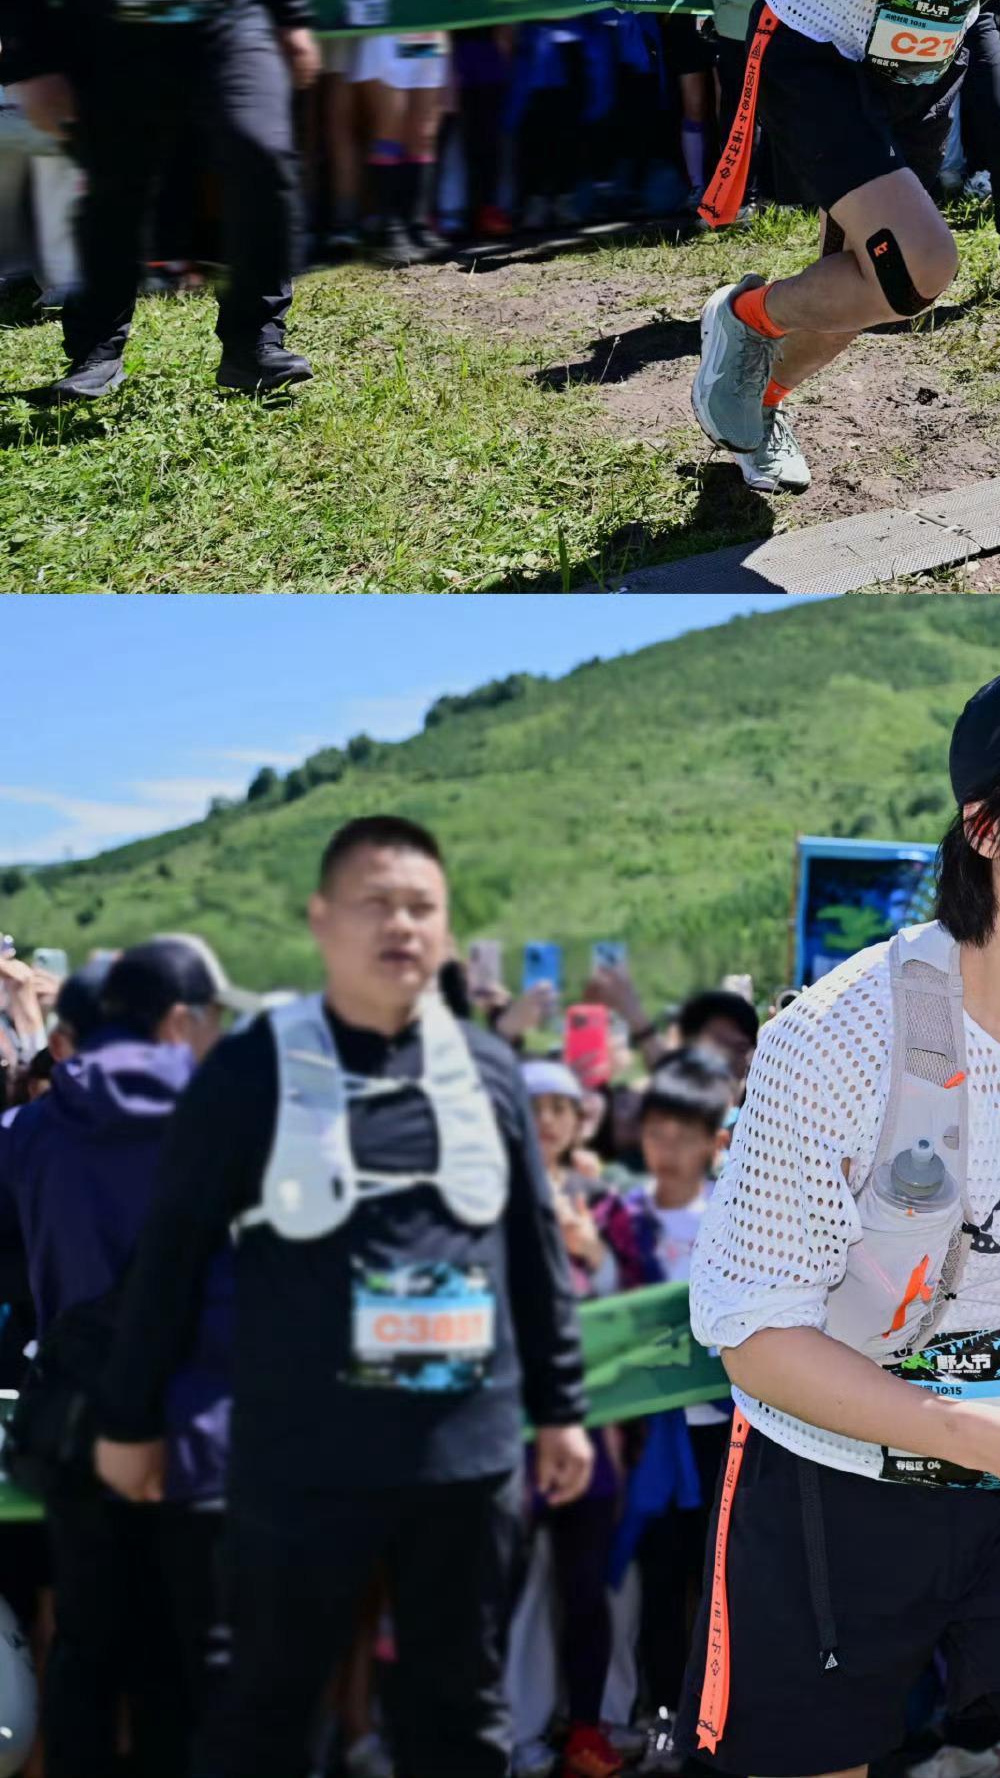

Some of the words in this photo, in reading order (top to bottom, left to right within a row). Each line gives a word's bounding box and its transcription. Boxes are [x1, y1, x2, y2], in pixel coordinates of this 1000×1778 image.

[916, 1, 950, 16] 野人节
[891, 32, 955, 57] C21
[936, 1354, 991, 1370] 野人节
[936, 1386, 962, 1395] 10:15
[896, 1460, 924, 1471] 存包区
[927, 1460, 942, 1471] 04
